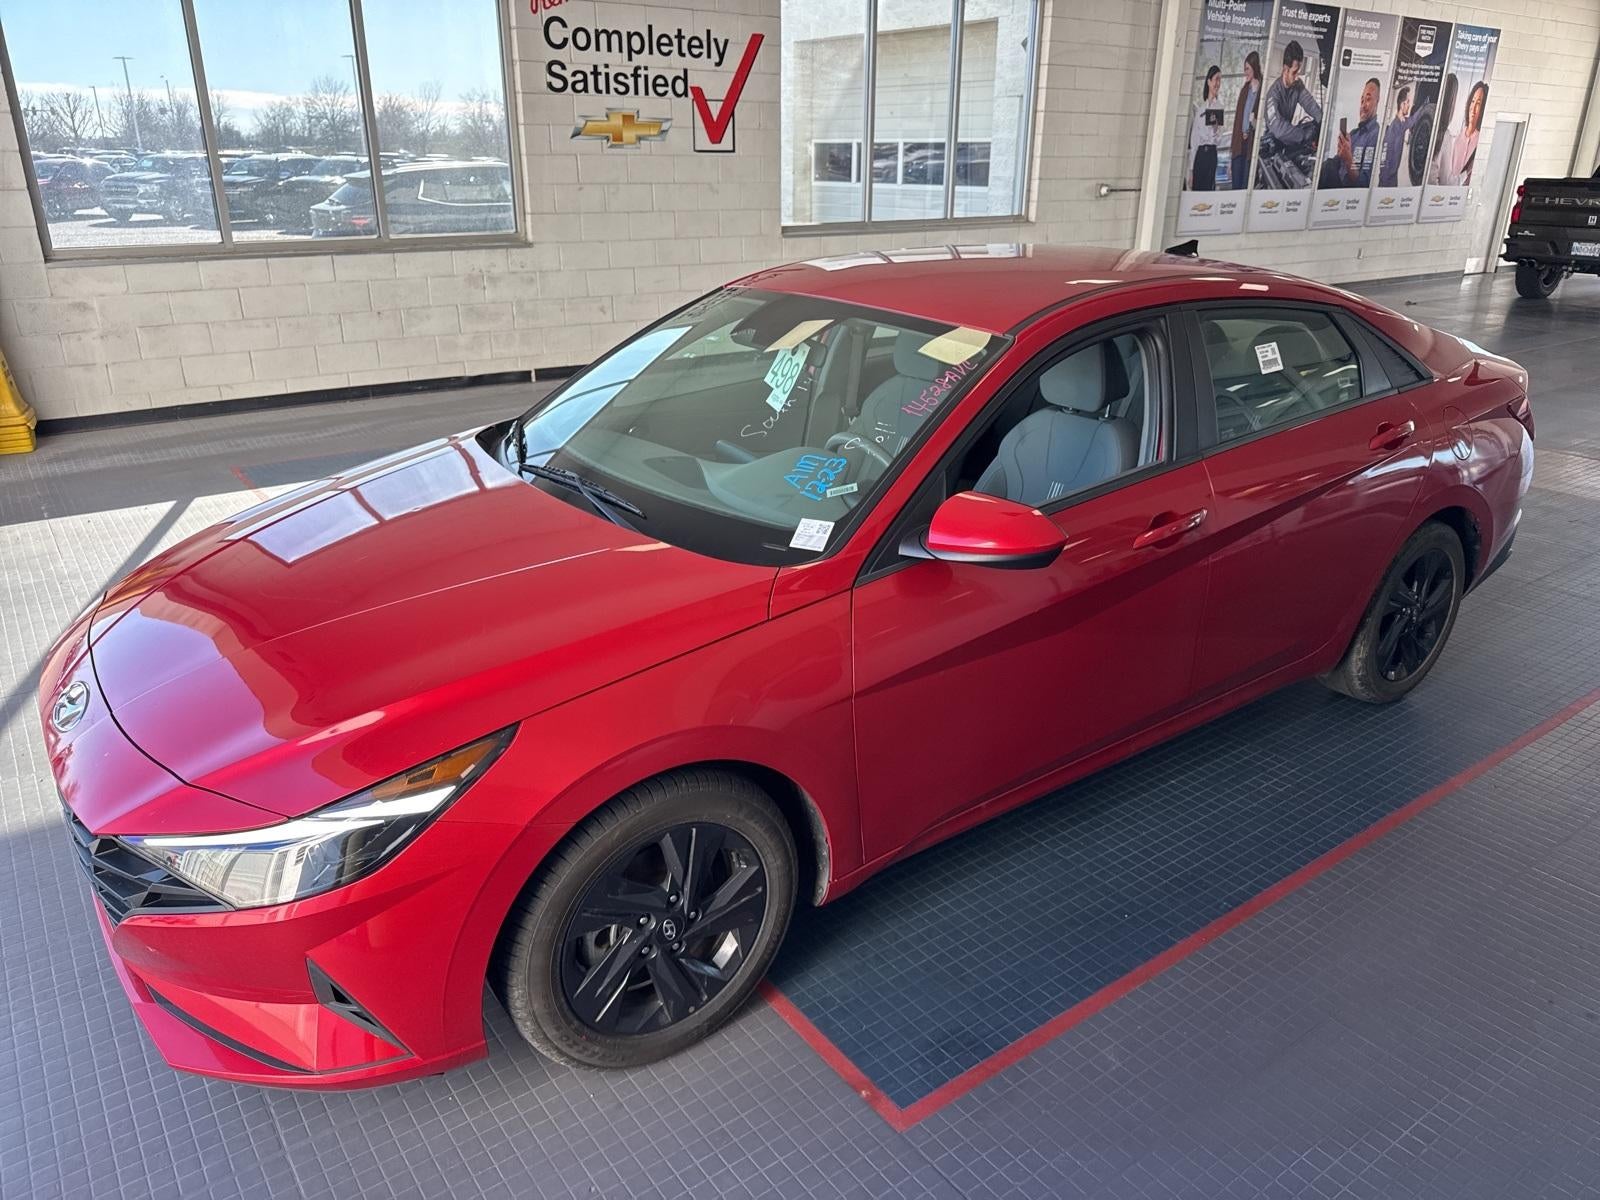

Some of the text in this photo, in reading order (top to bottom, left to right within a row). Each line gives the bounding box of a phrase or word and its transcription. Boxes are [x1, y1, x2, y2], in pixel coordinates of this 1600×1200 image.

[1207, 10, 1266, 28] Vehicle Inspection
[1281, 6, 1331, 24] Trust the experts
[1346, 15, 1381, 29] Maintenance
[543, 15, 729, 67] Completely
[1455, 40, 1469, 52] Chevy
[1457, 30, 1472, 42] Taking
[1471, 34, 1482, 42] care
[1486, 36, 1498, 45] your
[545, 59, 689, 98] Satisfied
[769, 352, 800, 395] 498
